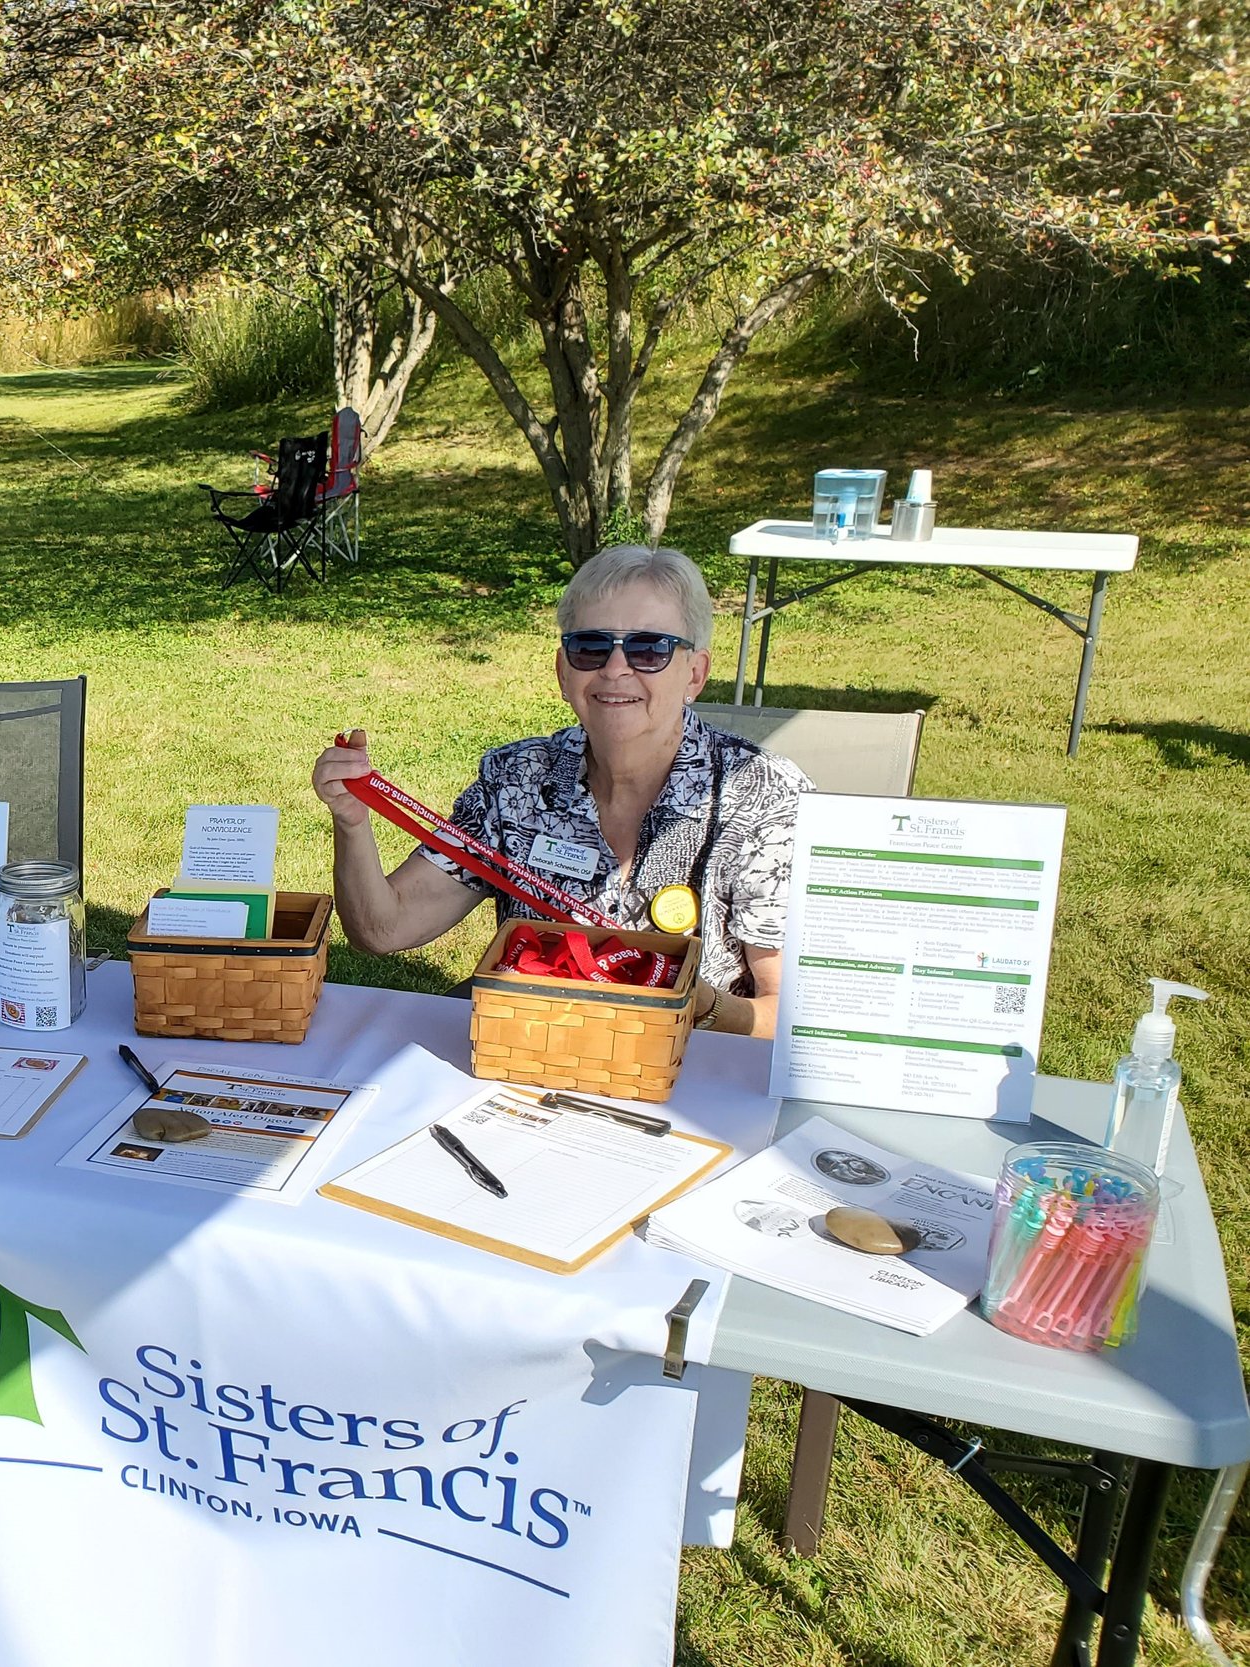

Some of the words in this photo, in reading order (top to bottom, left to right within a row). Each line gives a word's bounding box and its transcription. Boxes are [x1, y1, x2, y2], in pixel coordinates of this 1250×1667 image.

[209, 817, 237, 825] PRAYER
[370, 777, 494, 858] www.clintonfranciscans.com
[917, 815, 950, 828] Sisters
[949, 817, 959, 830] of
[201, 826, 253, 834] NONVIOLENCE
[909, 823, 924, 834] St.
[925, 825, 966, 838] Francis
[561, 843, 579, 854] Sisters
[811, 847, 841, 856] Franciscan
[841, 849, 858, 857] Peace
[941, 842, 963, 851] Center
[563, 850, 588, 861] Francis
[531, 855, 554, 866] Deborah
[580, 868, 592, 876] OSF
[507, 862, 562, 900] Nonviolence
[564, 896, 590, 918] Active
[838, 888, 858, 897] Action
[858, 889, 883, 898] Platform
[609, 948, 642, 964] Peace
[991, 957, 1022, 966] LAUDATO
[596, 958, 609, 972] &
[792, 1026, 814, 1036] Contact
[814, 1029, 848, 1039] Information
[216, 1107, 250, 1119] Alert
[252, 1113, 295, 1126] Digest
[915, 1173, 936, 1183] What
[869, 1275, 919, 1291] LIBRARY
[877, 1269, 926, 1287] CLINTON
[135, 1343, 425, 1450] Sisters
[442, 1398, 528, 1460] of
[98, 1376, 199, 1471] St.
[120, 1463, 263, 1524] CLINTON,
[273, 1505, 362, 1538] IOWA
